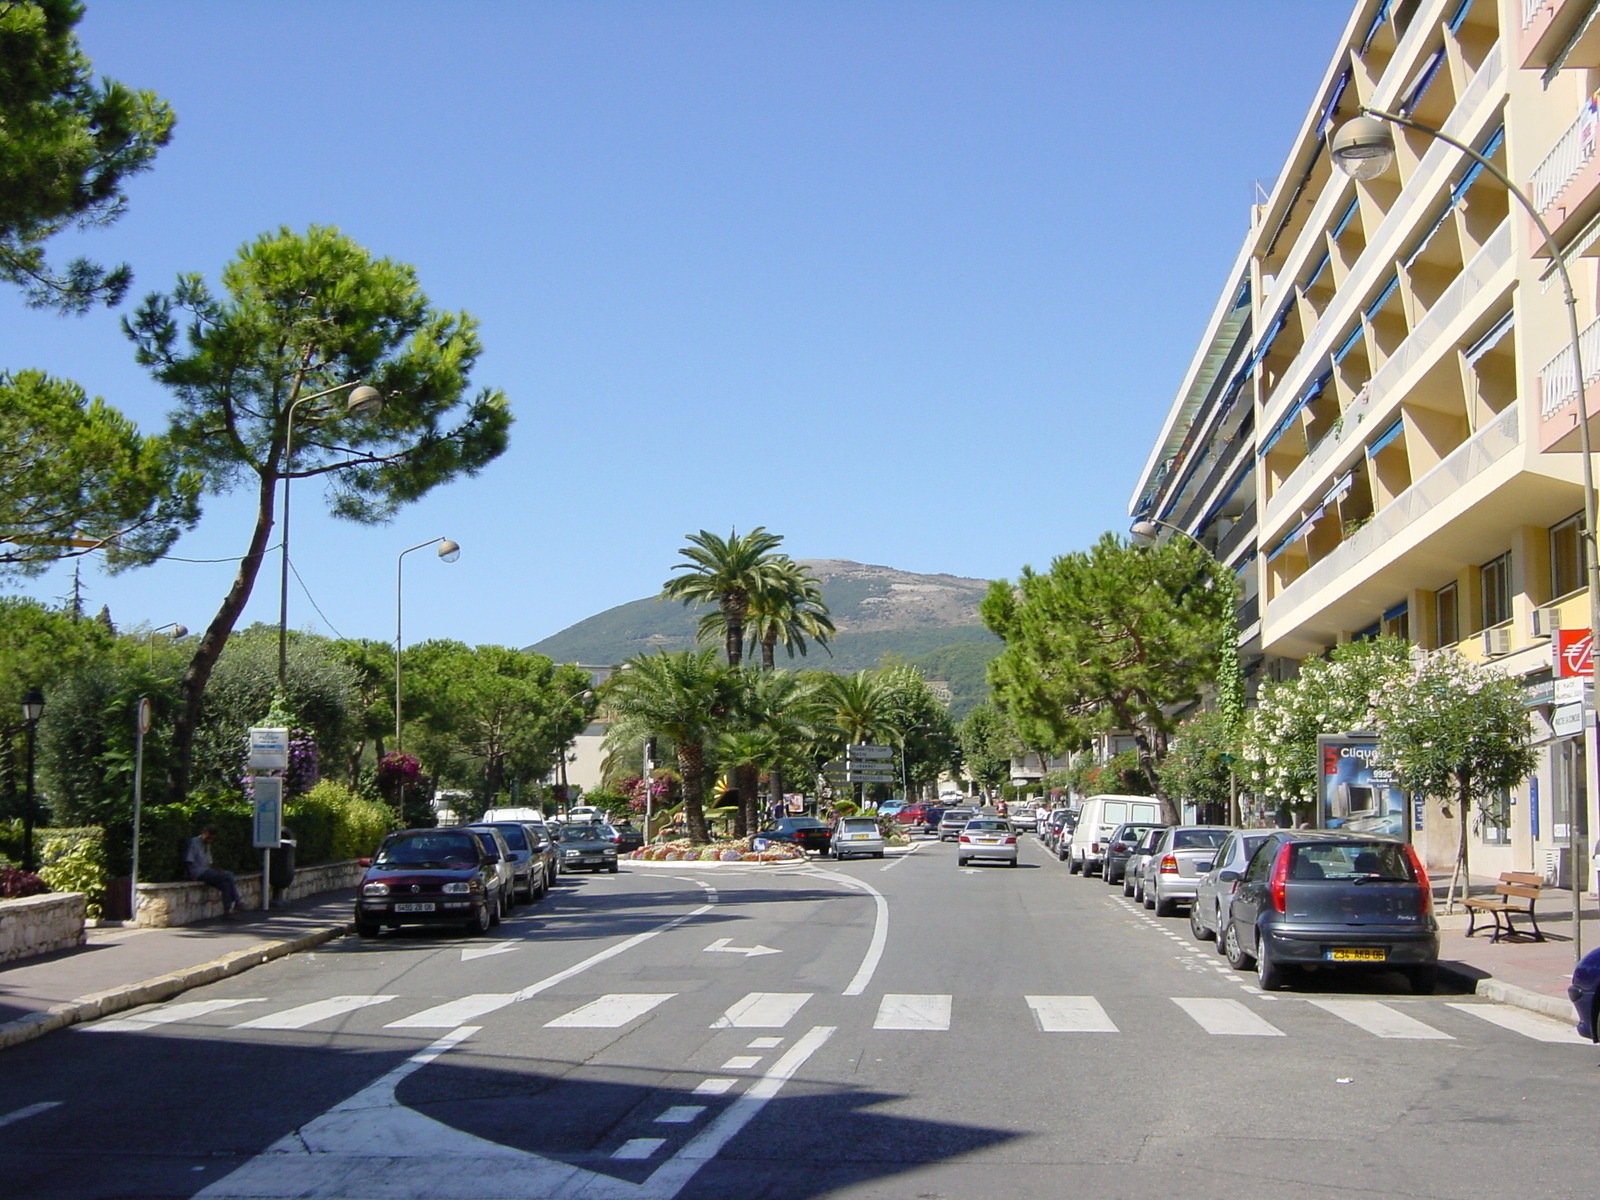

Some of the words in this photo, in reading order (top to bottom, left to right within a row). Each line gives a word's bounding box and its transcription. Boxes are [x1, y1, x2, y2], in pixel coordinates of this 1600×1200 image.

[1333, 948, 1350, 959] 234
[1354, 948, 1370, 959] AKB
[1372, 949, 1384, 960] 06
